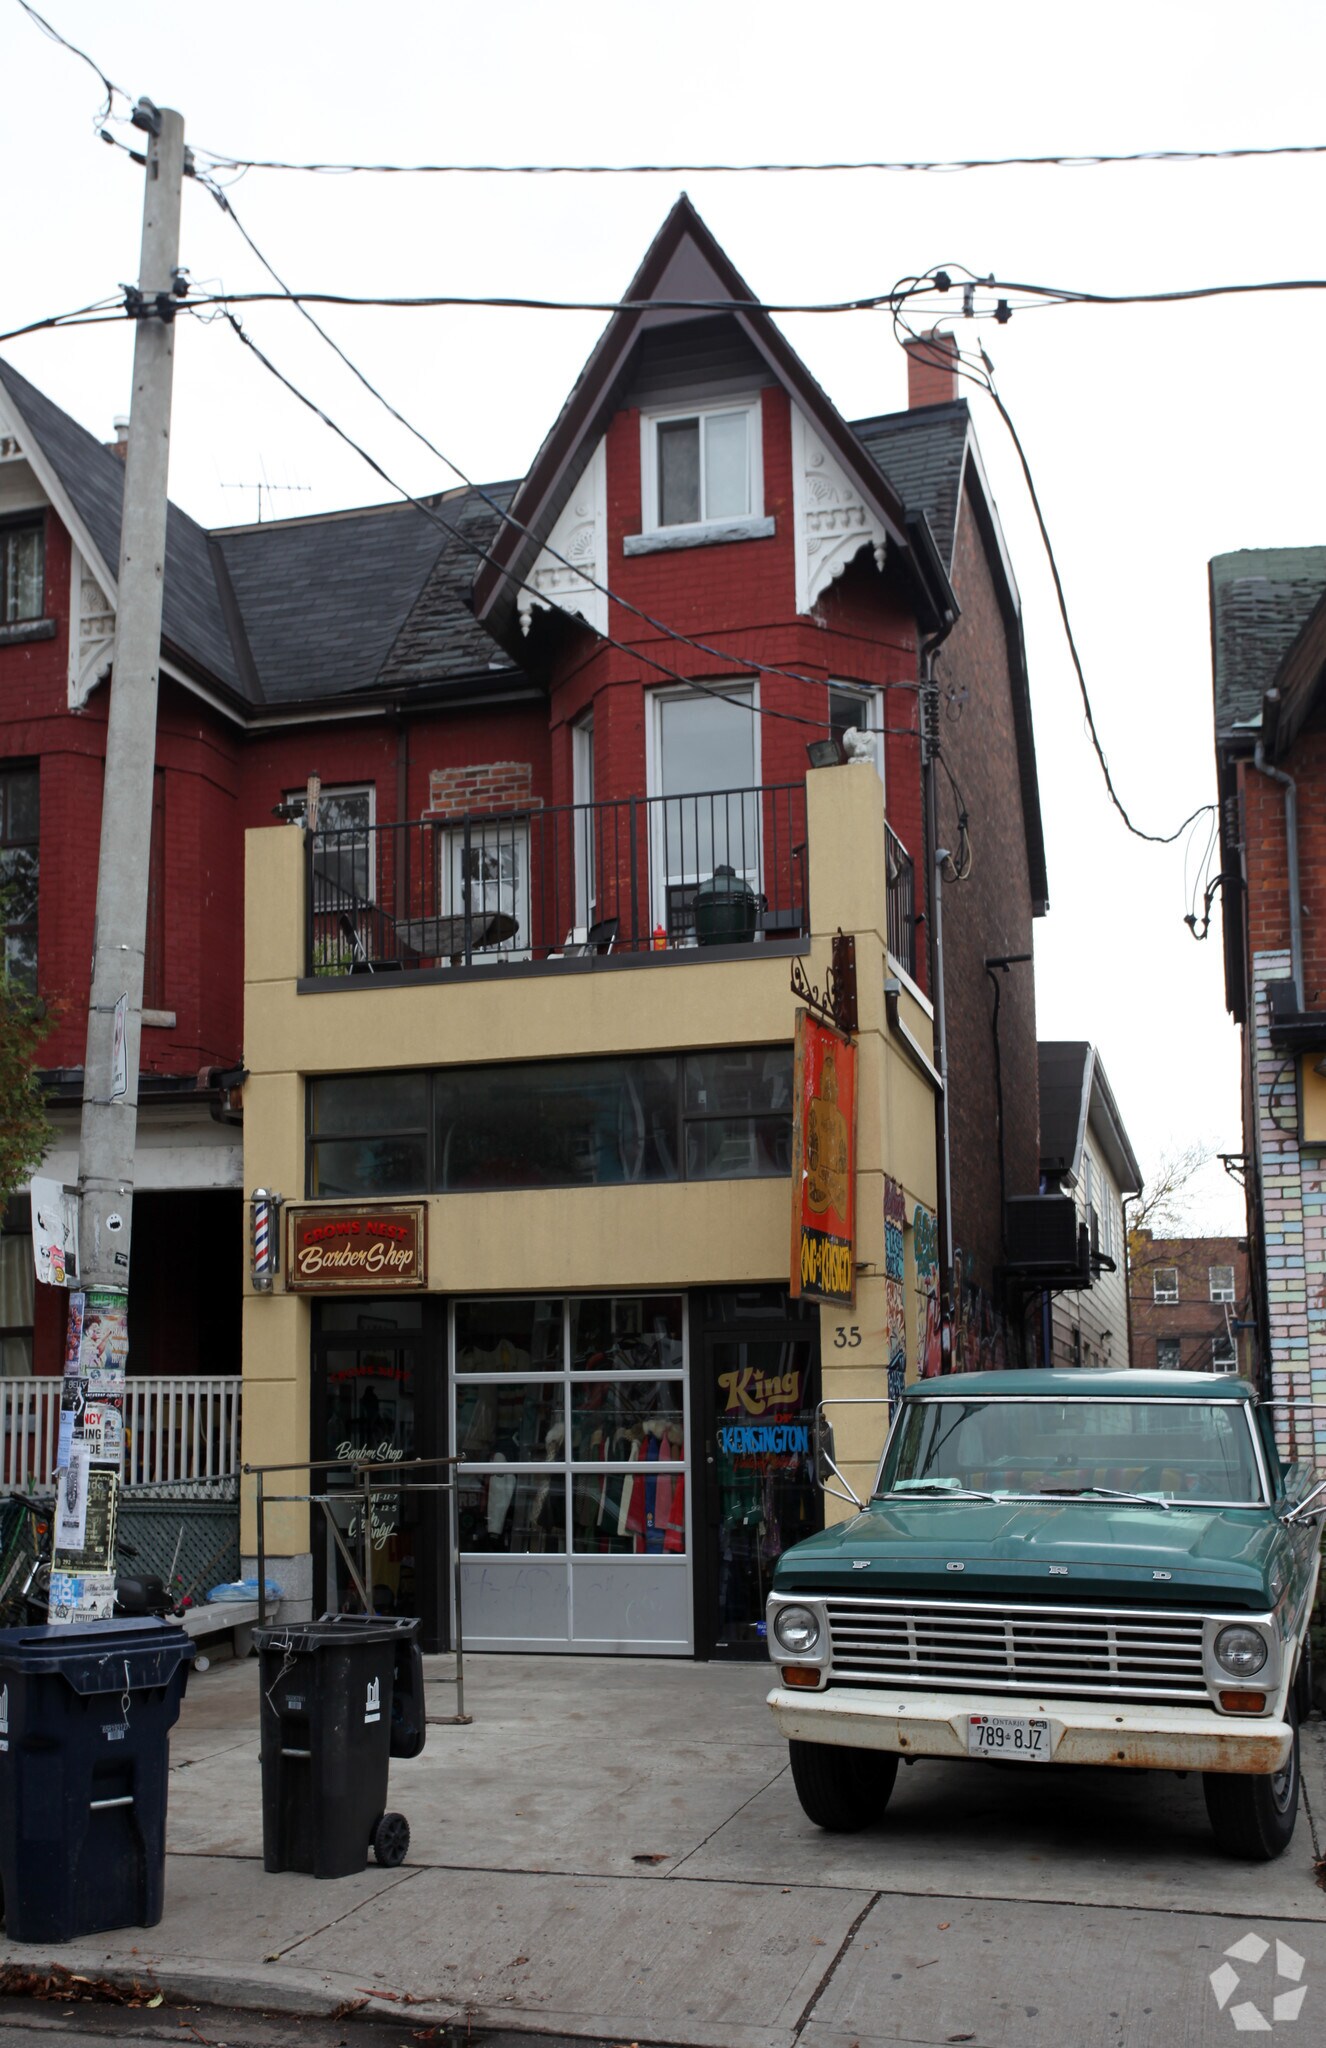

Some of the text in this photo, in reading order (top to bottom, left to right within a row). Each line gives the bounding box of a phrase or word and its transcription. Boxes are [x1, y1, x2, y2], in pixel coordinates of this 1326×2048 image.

[303, 1221, 408, 1245] CROWS NEST
[833, 1326, 862, 1349] 35
[718, 1366, 800, 1415] King
